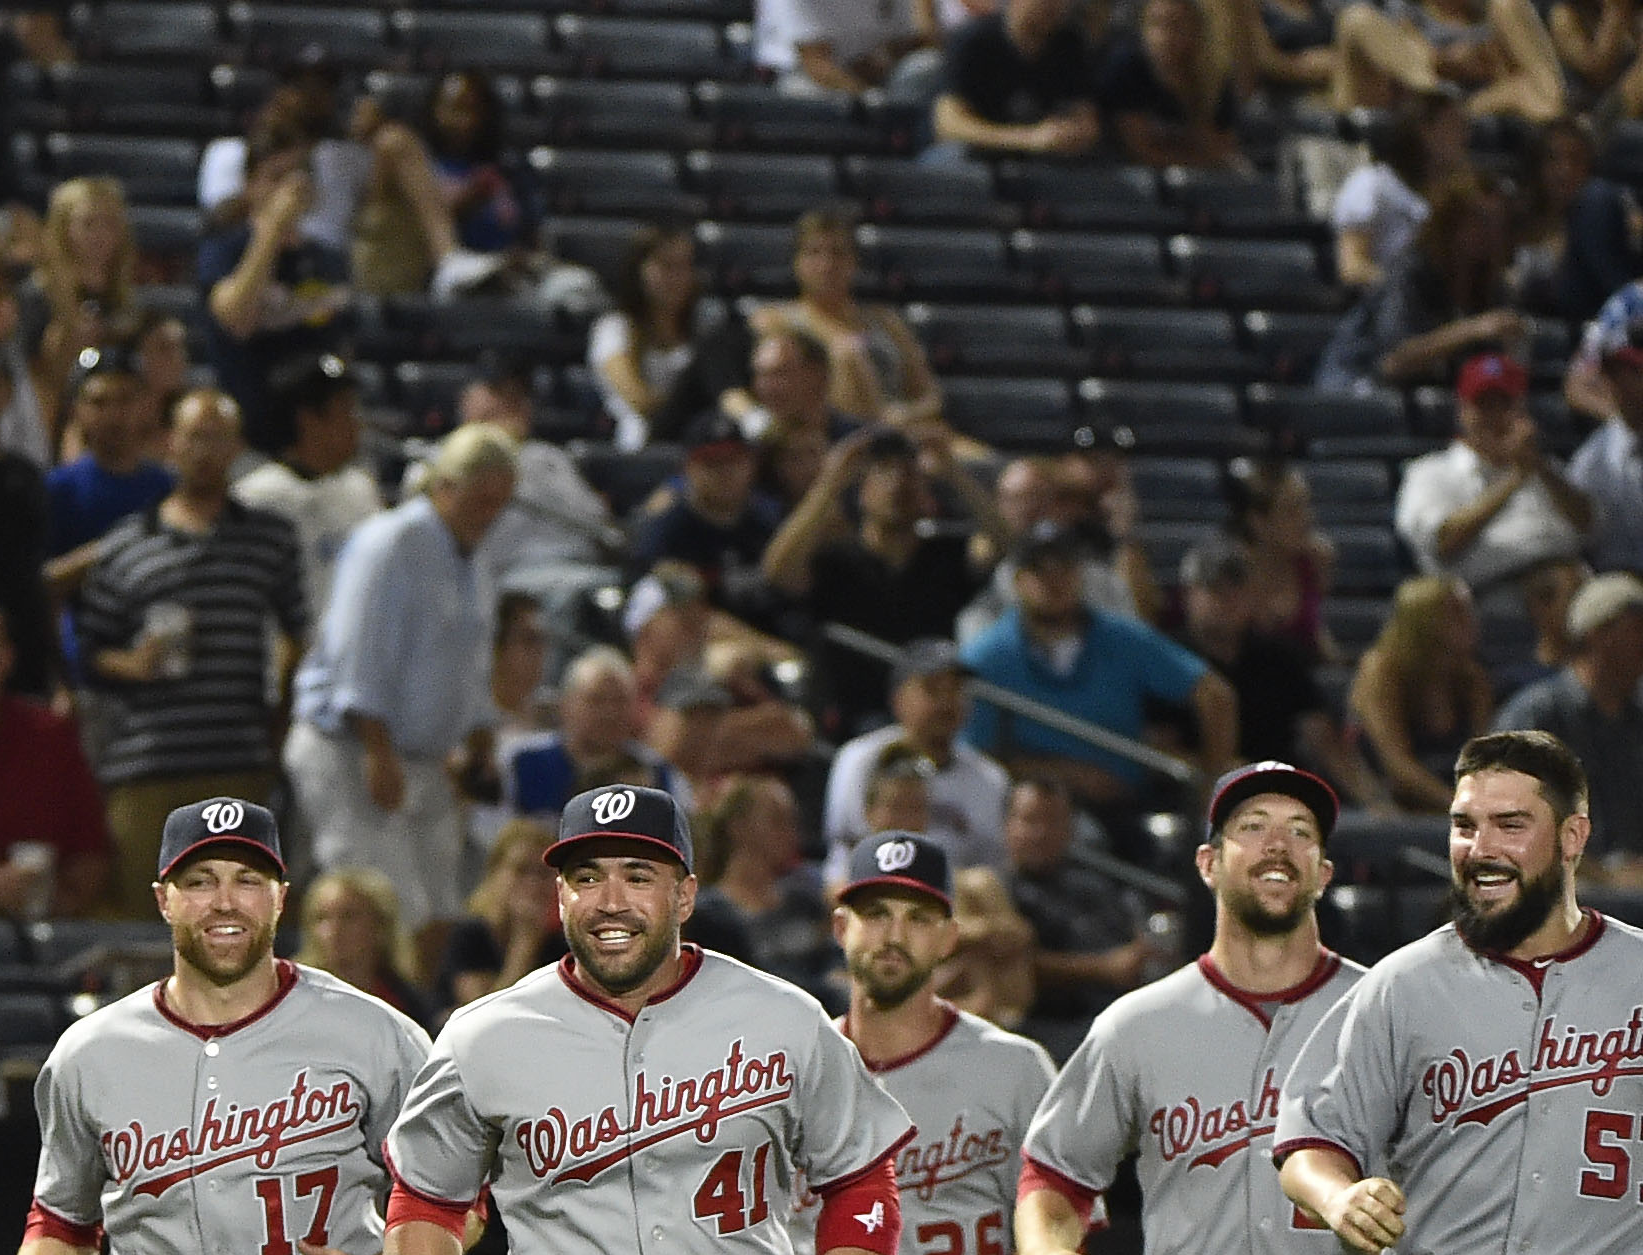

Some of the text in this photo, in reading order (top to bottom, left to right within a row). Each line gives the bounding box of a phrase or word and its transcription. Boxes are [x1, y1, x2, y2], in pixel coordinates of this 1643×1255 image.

[202, 803, 243, 833] W
[592, 791, 635, 824] W
[876, 841, 914, 870] W
[516, 1036, 794, 1185] Washington
[1423, 1005, 1643, 1132] Washingt
[100, 1066, 360, 1198] Washington
[1580, 1108, 1643, 1204] 5
[692, 1138, 771, 1236] 41
